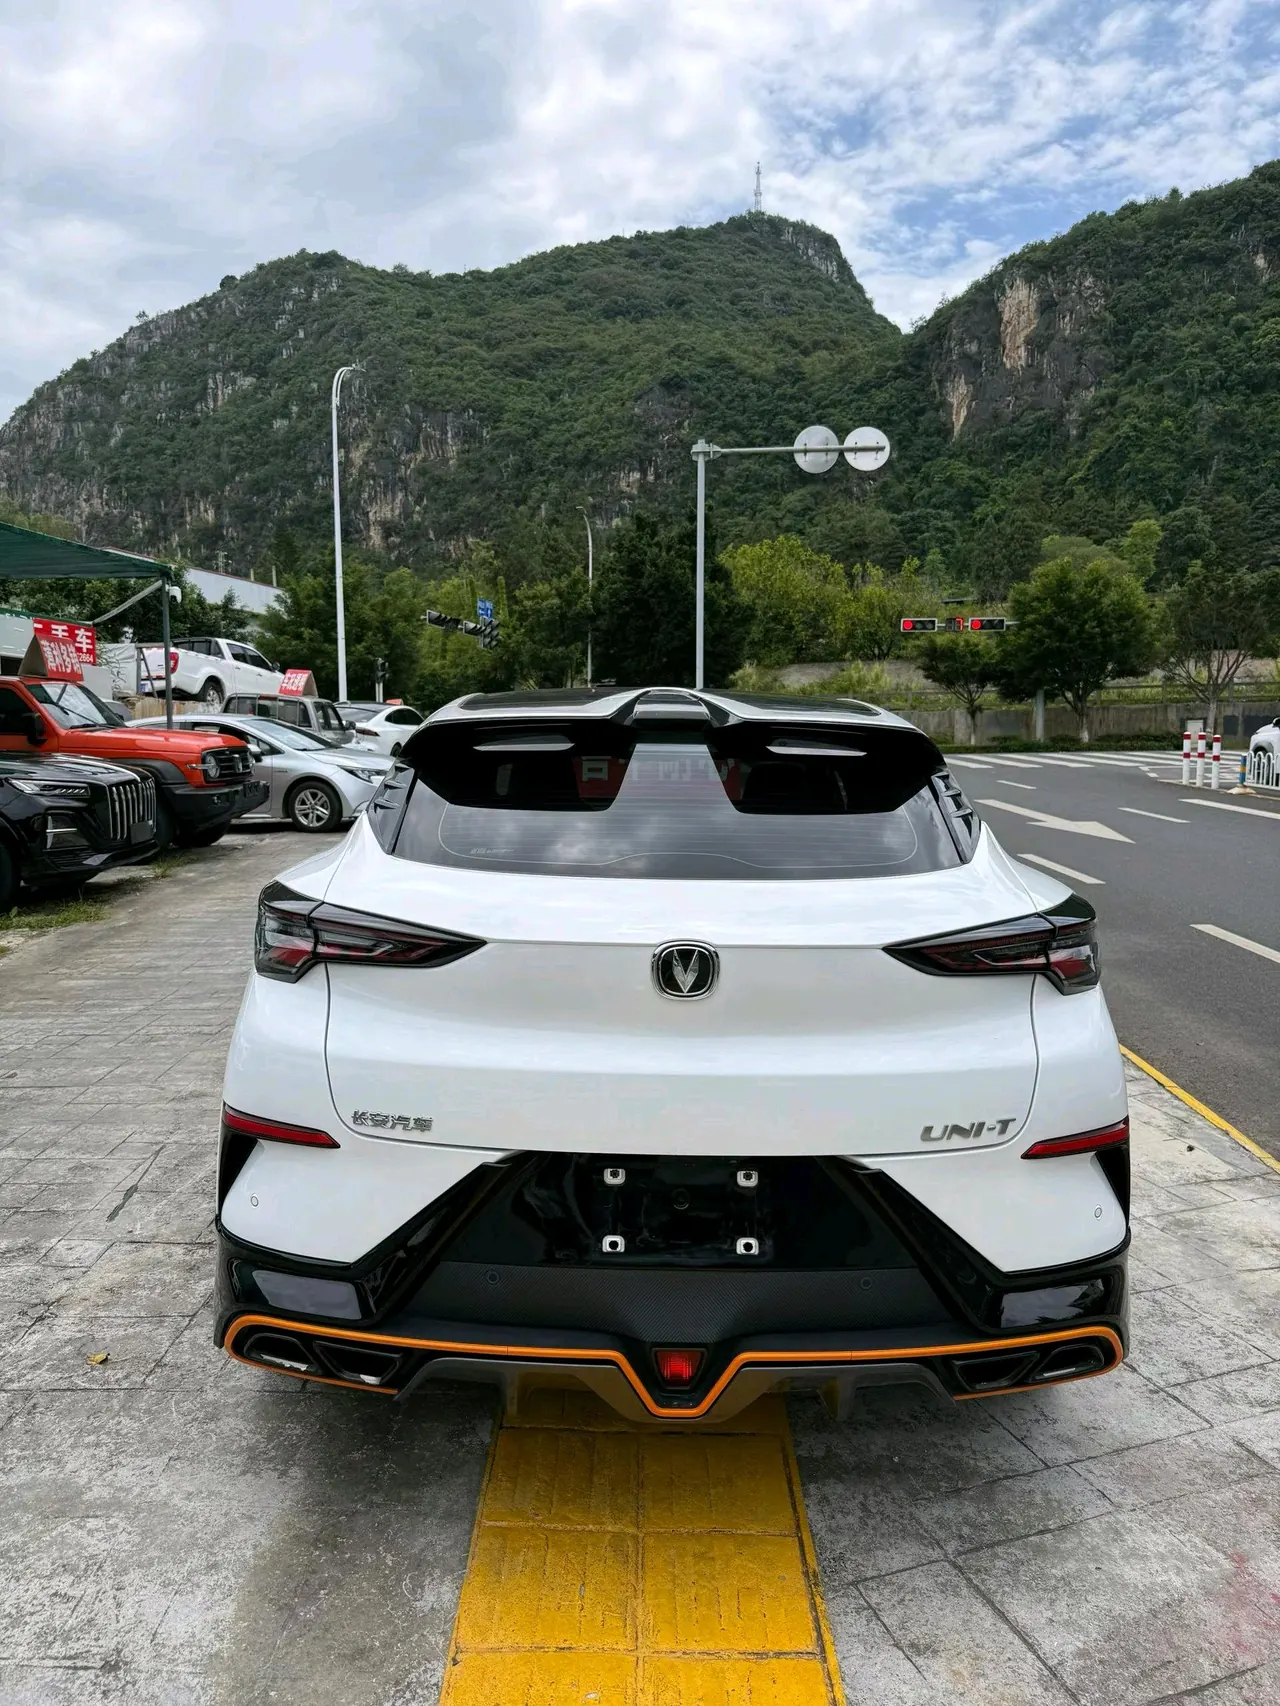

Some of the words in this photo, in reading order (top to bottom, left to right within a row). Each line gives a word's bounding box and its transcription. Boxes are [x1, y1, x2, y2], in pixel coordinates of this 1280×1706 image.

[352, 1110, 433, 1132] 长安汽车
[920, 1117, 1017, 1142] UNI-T
